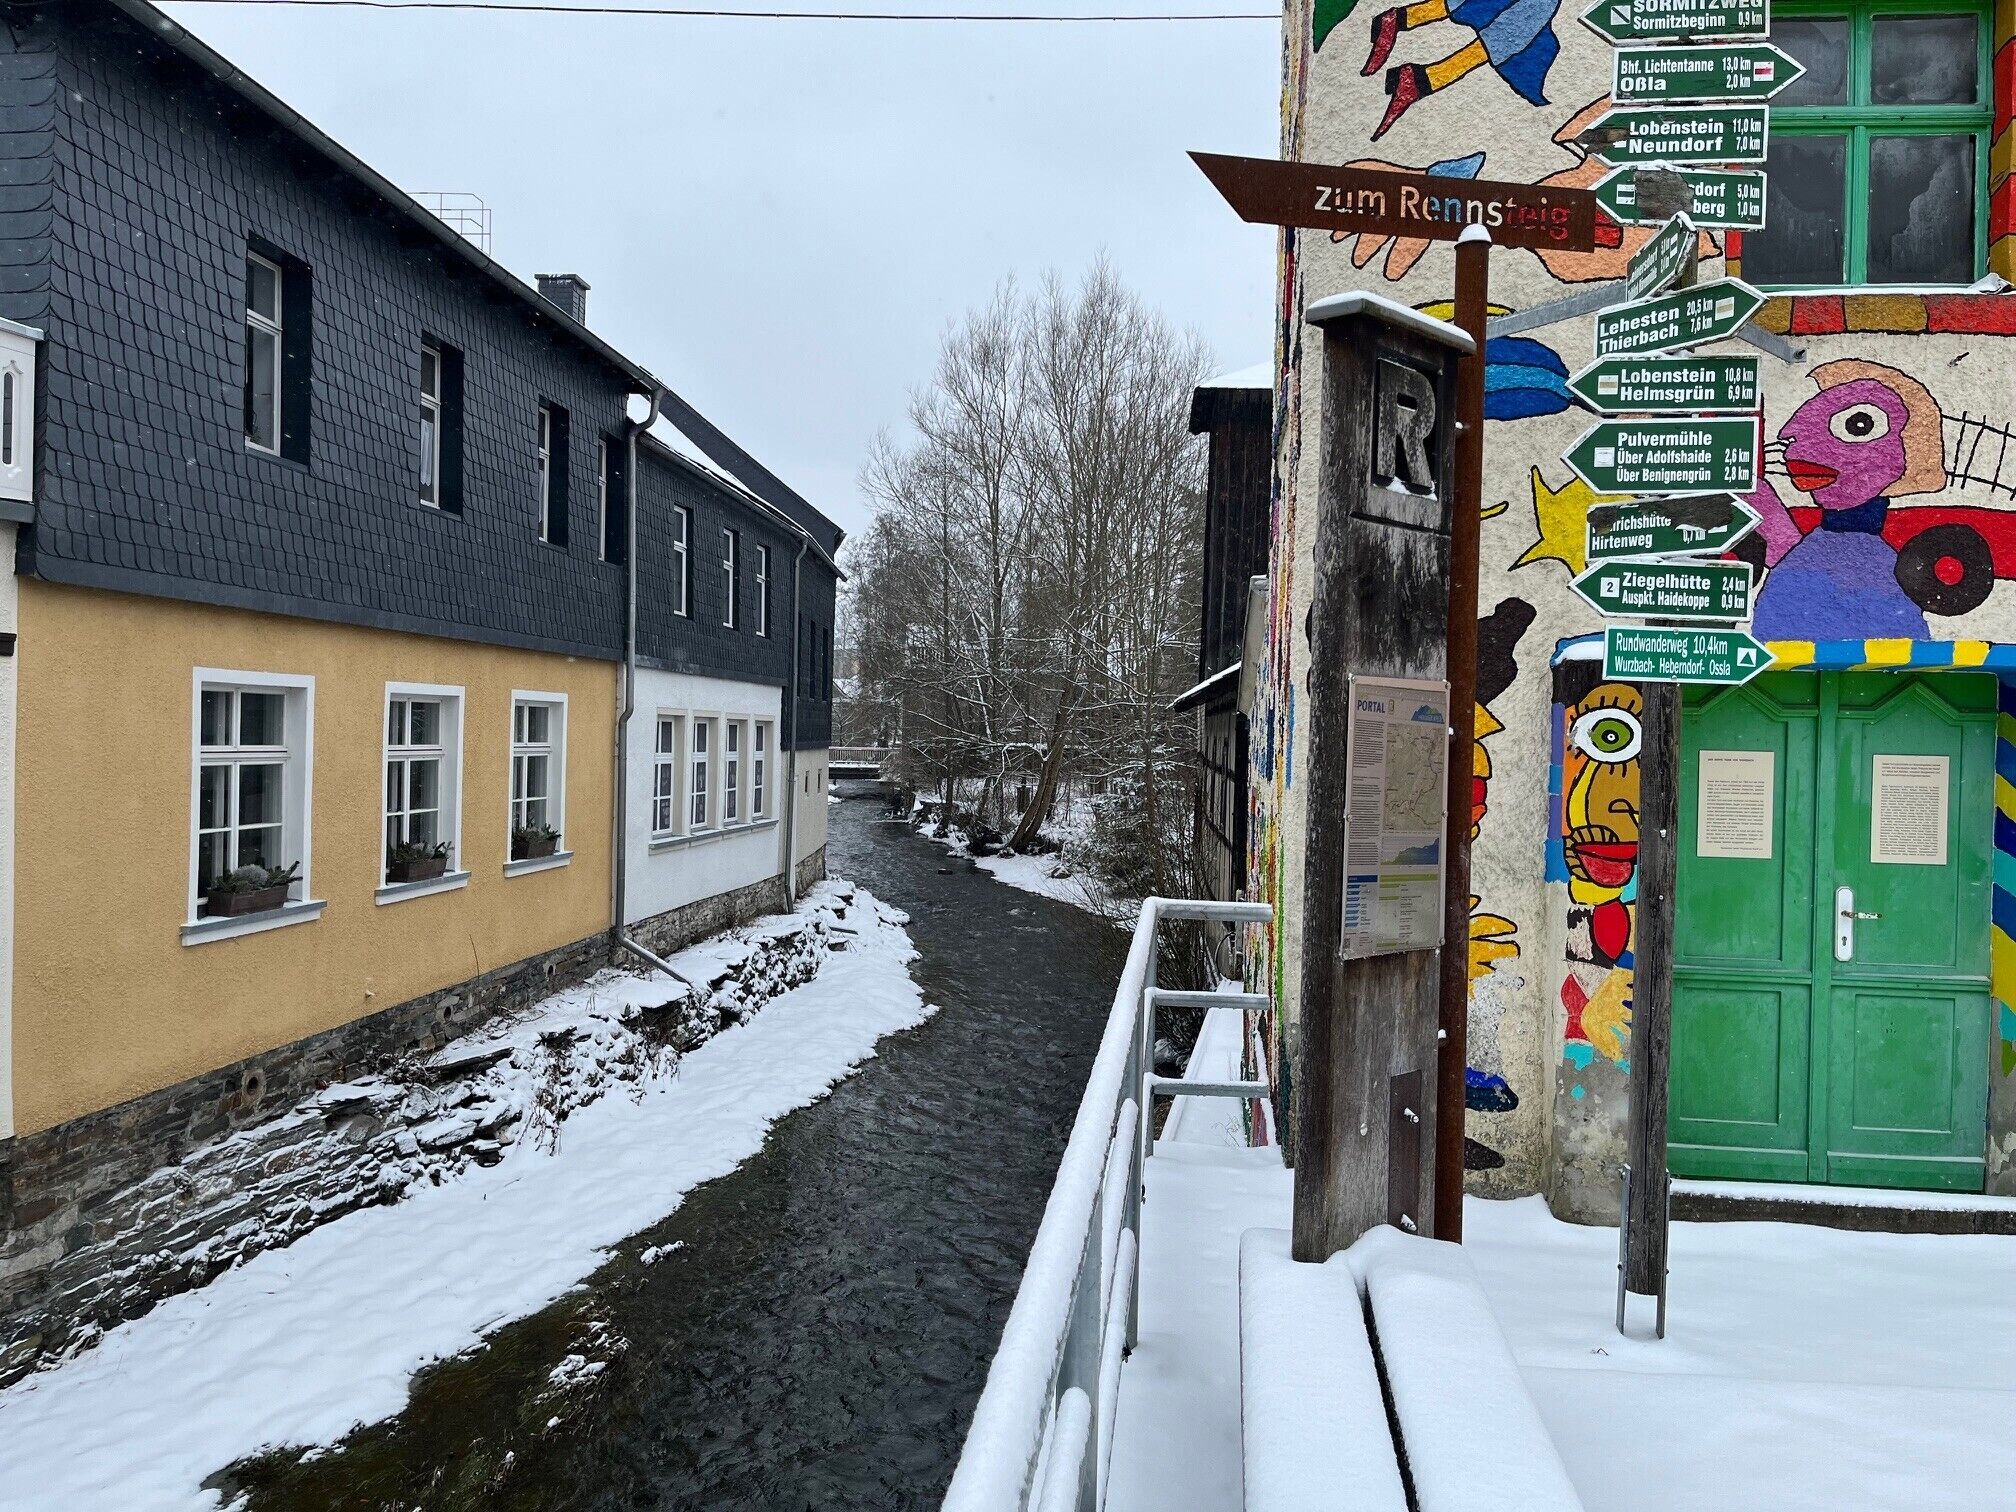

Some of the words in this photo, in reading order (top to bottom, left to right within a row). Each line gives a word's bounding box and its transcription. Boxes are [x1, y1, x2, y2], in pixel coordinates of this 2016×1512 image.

[1633, 0, 1762, 13] SORMITZWEG
[1633, 13, 1726, 30] Sormitzbeginn
[1738, 11, 1750, 27] 0,9
[1751, 10, 1762, 25] km
[1621, 60, 1642, 75] Bhf.
[1645, 58, 1714, 74] Lichtentanne
[1722, 58, 1739, 73] 13,0
[1740, 57, 1751, 70] km
[1621, 77, 1667, 92] Oßla
[1726, 75, 1738, 89] 2,0
[1739, 75, 1750, 88] km
[1630, 118, 1724, 136] Lobenstein
[1733, 119, 1749, 135] 11,0
[1750, 118, 1761, 132] km
[1629, 136, 1722, 154] Neundorf
[1736, 137, 1748, 152] 7,0
[1749, 136, 1760, 150] km
[1737, 184, 1748, 200] 5,0
[1749, 184, 1760, 199] km
[1315, 185, 1386, 217] zum
[1401, 186, 1571, 242] Rennsteig
[1737, 201, 1748, 218] 1,0
[1749, 201, 1760, 216] km
[1600, 307, 1680, 338] Lehesten
[1686, 299, 1702, 317] 20,5
[1702, 297, 1713, 312] km
[1599, 322, 1679, 355] Thierbach
[1690, 317, 1701, 334] 7,6
[1702, 315, 1713, 330] km
[1621, 368, 1716, 384] Lobenstein
[1725, 368, 1741, 384] 10,8
[1742, 368, 1753, 382] km
[1621, 386, 1715, 403] Helmsgrün
[1728, 386, 1740, 401] 6,9
[1741, 385, 1753, 399] km
[1377, 358, 1436, 488] R
[1618, 431, 1713, 447] Pulvermühle
[1617, 449, 1644, 464] Über
[1646, 448, 1712, 464] Adolfshaide
[1725, 449, 1737, 464] 2,6
[1738, 448, 1750, 462] km
[1616, 467, 1641, 482] Über
[1642, 467, 1711, 484] Benignengrün
[1724, 467, 1736, 482] 2,8
[1738, 467, 1749, 481] km
[1592, 533, 1653, 550] Hirtenweg
[1606, 582, 1614, 593] 2
[1622, 571, 1711, 591] Ziegelhütte
[1722, 577, 1735, 592] 2,4
[1735, 577, 1746, 591] km
[1622, 590, 1655, 607] Auspkt.
[1657, 591, 1710, 608] Haidekoppe
[1721, 594, 1733, 610] 0,9
[1734, 595, 1744, 609] km
[1616, 633, 1688, 658] Rundwanderweg
[1693, 637, 1728, 657] 10,4km
[1614, 656, 1655, 674] Wurzbach-
[1659, 657, 1705, 675] Heberndorf-
[1709, 661, 1731, 676] Ossla
[1357, 700, 1386, 714] PORTAL
